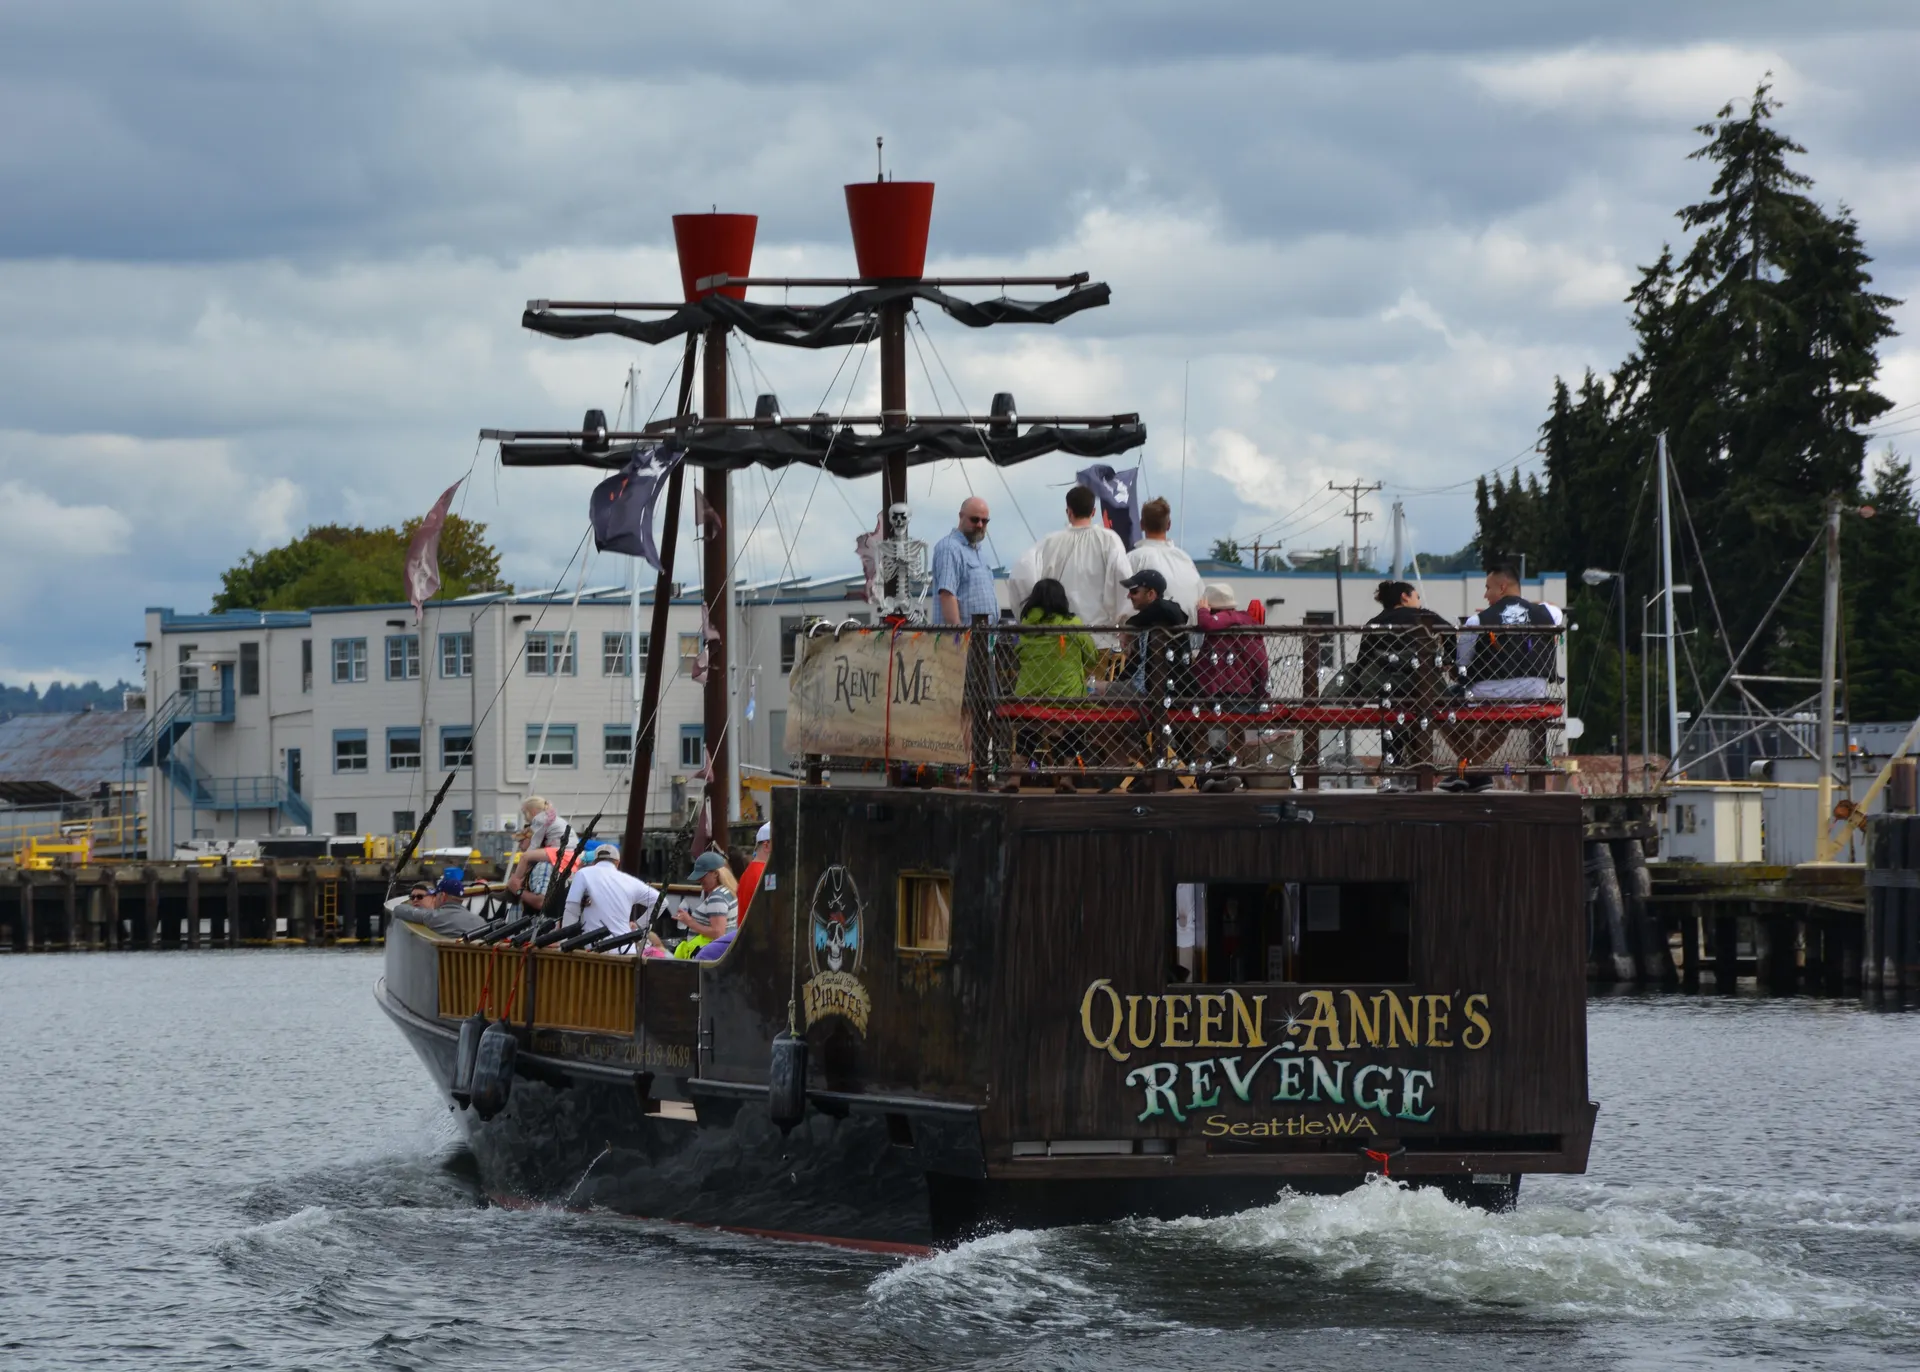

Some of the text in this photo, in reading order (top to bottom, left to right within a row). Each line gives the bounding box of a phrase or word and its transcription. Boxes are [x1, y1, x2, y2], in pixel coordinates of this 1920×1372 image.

[810, 984, 862, 1018] PIRATES
[1079, 978, 1492, 1062] QUEEN ANNE'S
[623, 1043, 691, 1068] 206-639-8689
[1125, 1041, 1436, 1123] REVENGE
